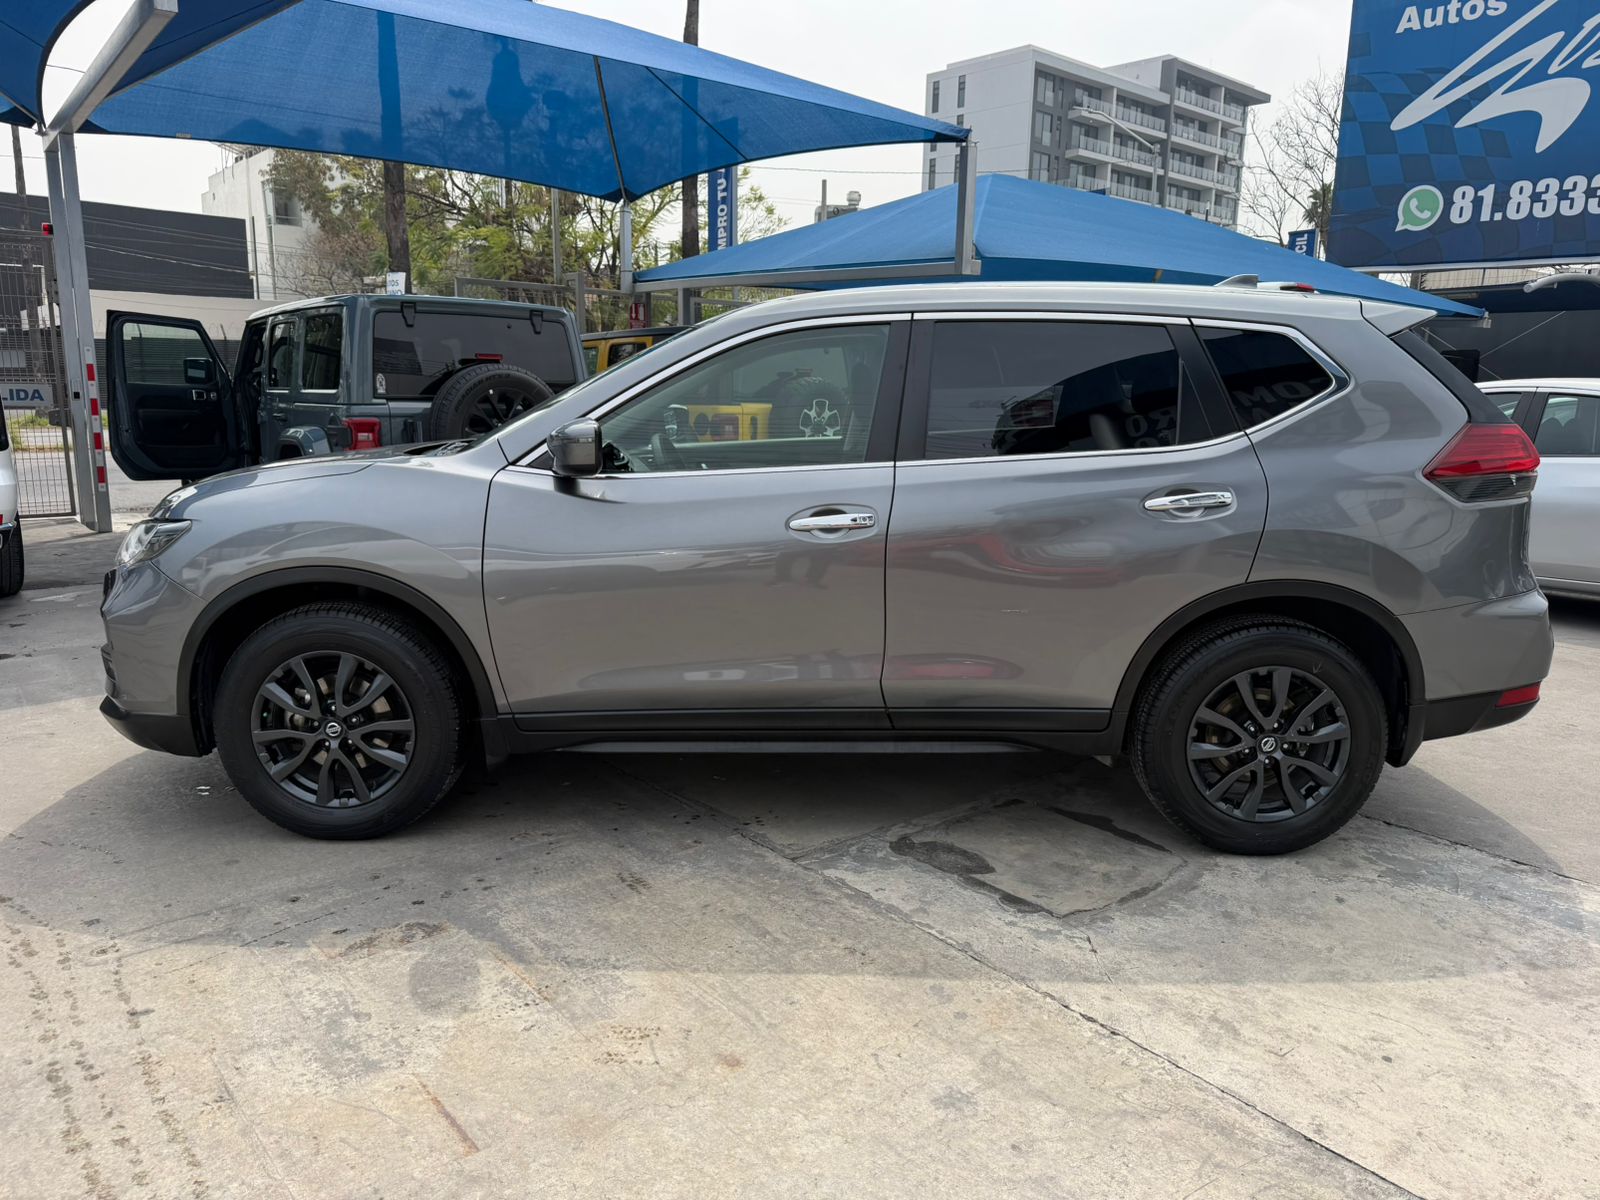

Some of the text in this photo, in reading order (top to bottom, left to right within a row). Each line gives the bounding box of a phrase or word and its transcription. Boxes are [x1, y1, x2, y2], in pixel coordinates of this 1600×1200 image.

[1396, 0, 1508, 34] Autos
[717, 178, 727, 201] TU
[1295, 233, 1308, 255] CIL
[2, 388, 45, 401] IDA
